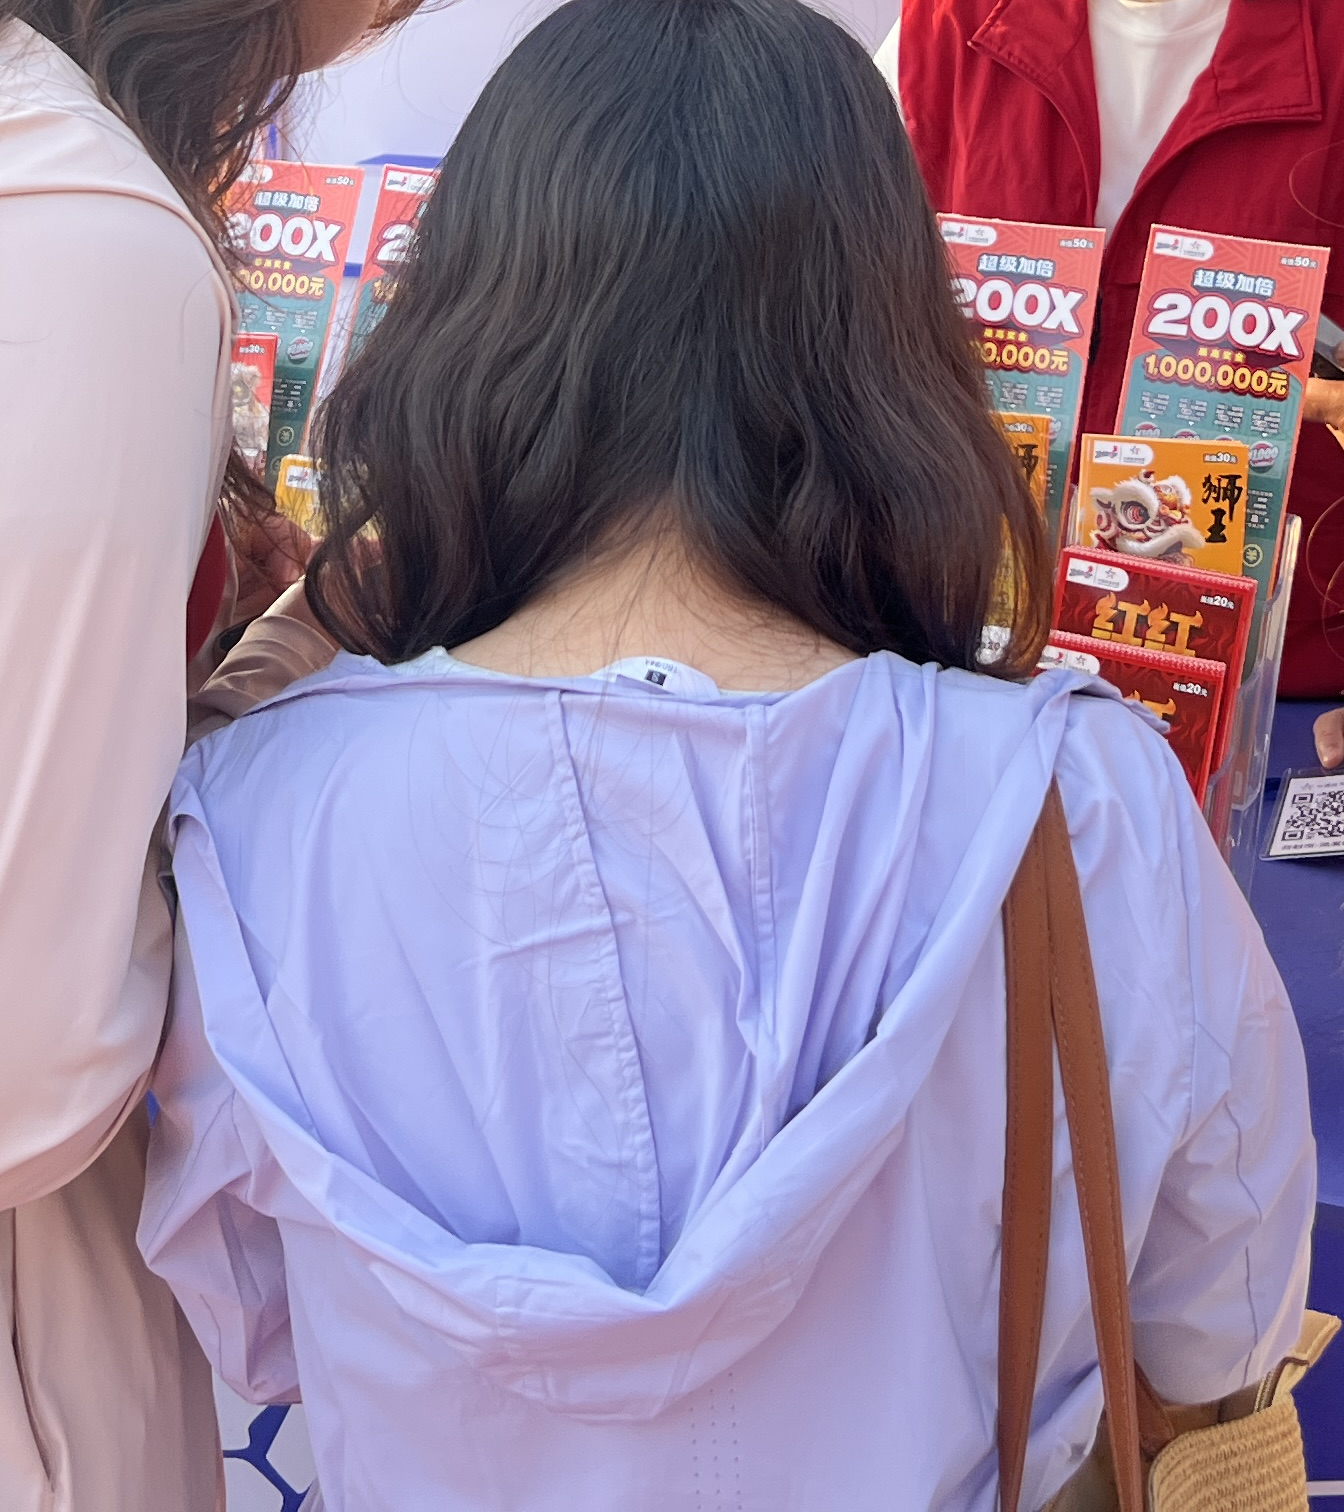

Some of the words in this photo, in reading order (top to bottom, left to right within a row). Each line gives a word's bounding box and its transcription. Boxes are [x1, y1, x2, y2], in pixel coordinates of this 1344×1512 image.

[978, 254, 1054, 277] 超级加倍
[1193, 269, 1275, 296] 超级加倍
[1148, 292, 1304, 356] 200X
[1145, 354, 1288, 396] 1,000,000元
[1202, 473, 1243, 543] 狮王
[1091, 592, 1203, 657] 红红
